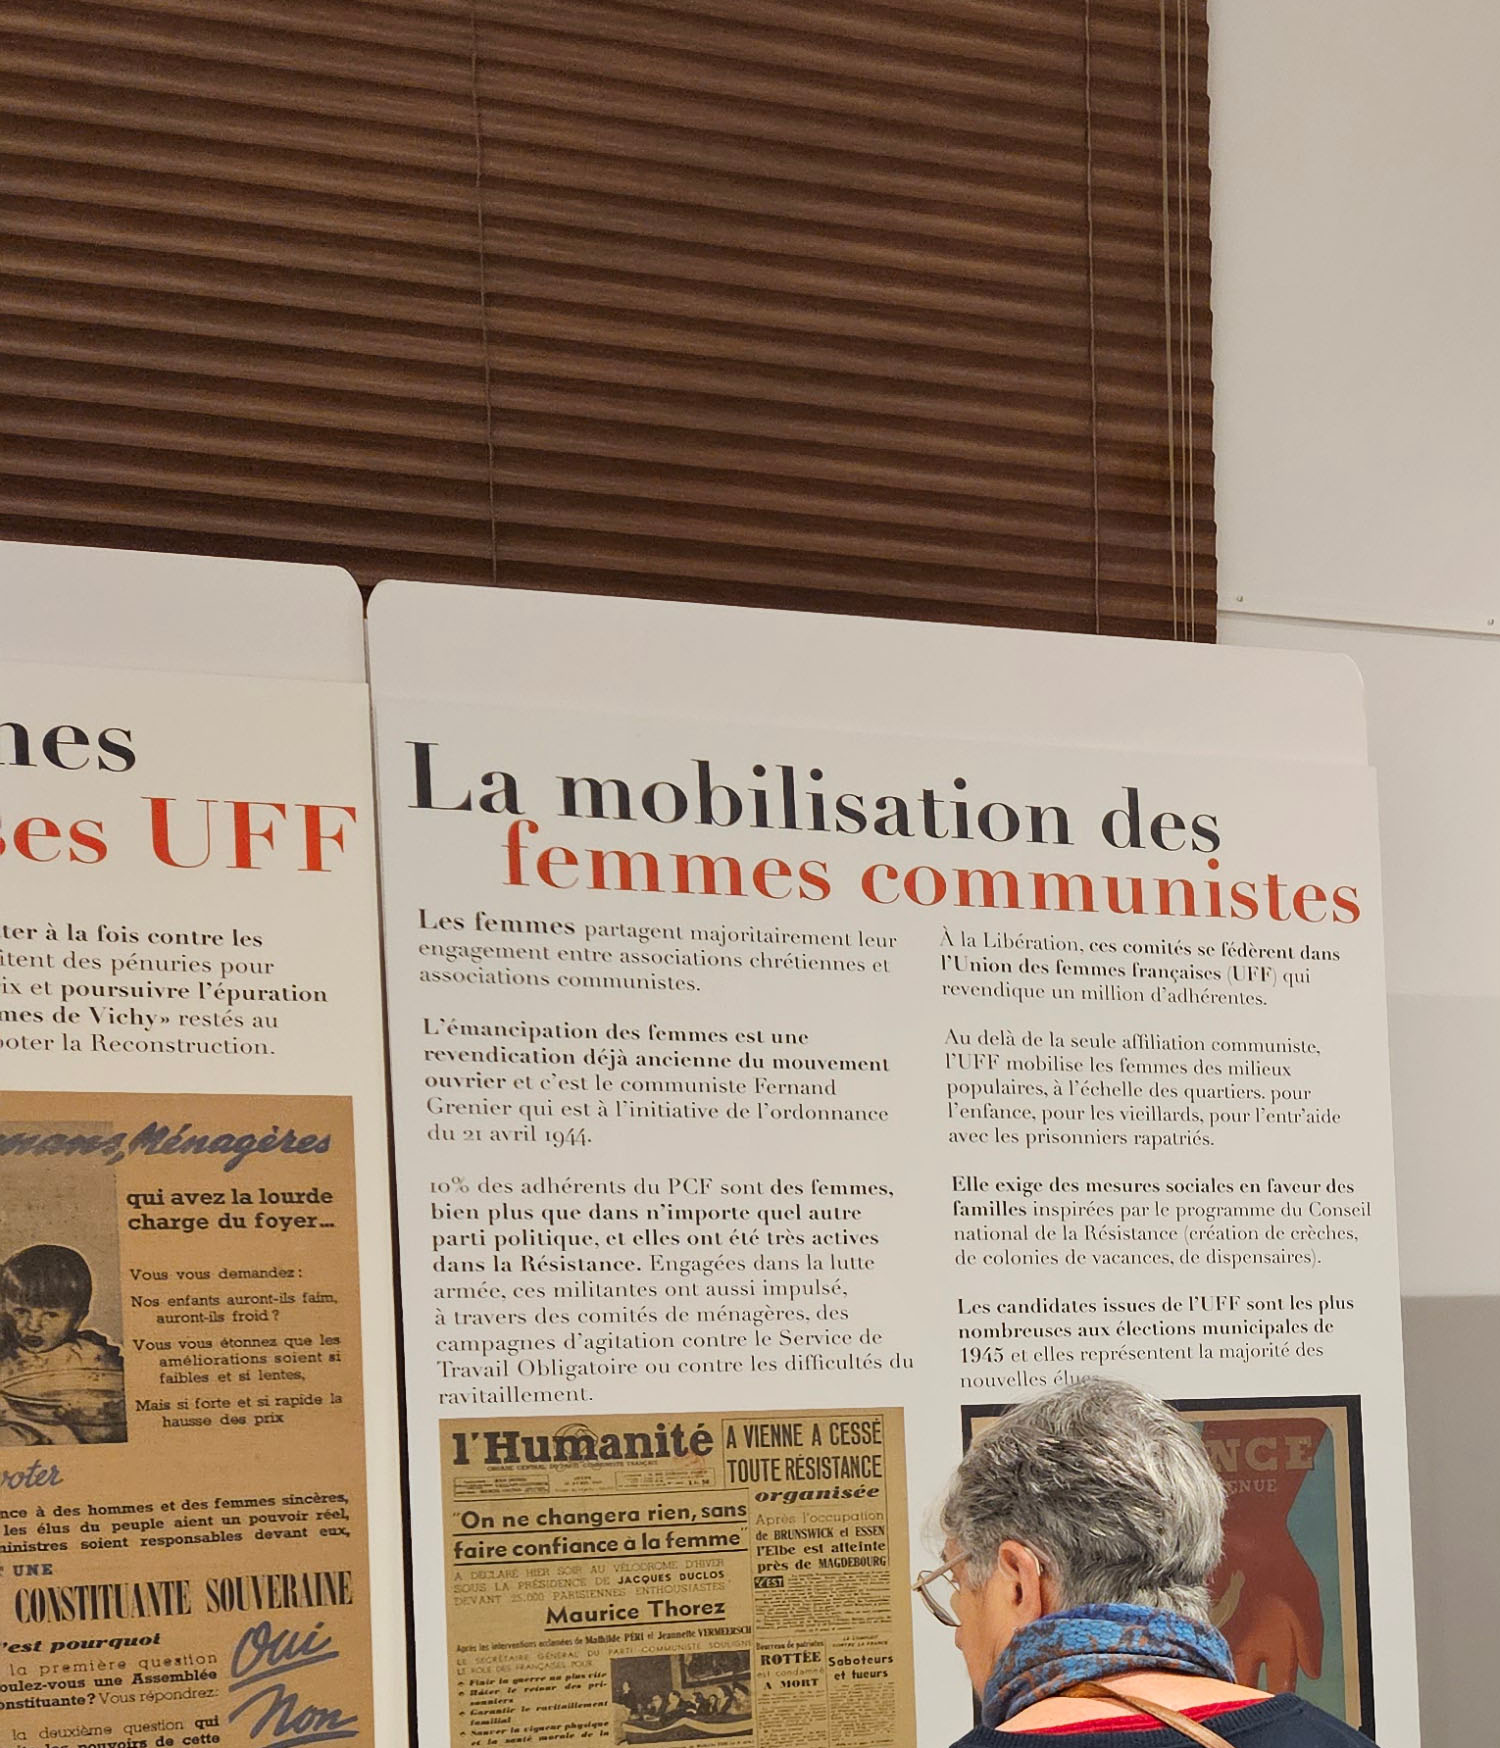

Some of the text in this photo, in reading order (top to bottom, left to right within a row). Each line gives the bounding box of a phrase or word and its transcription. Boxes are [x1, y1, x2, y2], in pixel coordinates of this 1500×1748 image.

[405, 741, 1221, 853] La mobilisation des
[141, 796, 357, 872] UFF
[501, 819, 1361, 924] femmes communistes
[45, 922, 58, 941] à
[67, 922, 89, 942] la
[97, 924, 140, 944] fois
[147, 931, 224, 946] contre
[232, 928, 263, 947] les
[419, 908, 897, 948] Les femmes partagent majoritairement leur
[30, 981, 50, 996] et
[61, 980, 190, 1003] poursuivre
[198, 981, 328, 1007] l'épuration
[52, 1005, 81, 1024] de
[88, 1006, 170, 1032] Vichy»
[179, 1009, 244, 1028] restés
[252, 1016, 278, 1028] au
[0, 1032, 275, 1055] oter la Reconstruction.
[423, 1045, 892, 1072] revendication déjà ancienne du mouvement
[128, 1121, 331, 1173] Ménagères
[125, 1187, 334, 1210] qui avez la lourde
[952, 1175, 1355, 1198] Elle exige des mesures sociales en faveur des
[127, 1212, 210, 1234] charge
[217, 1212, 248, 1230] du
[431, 1202, 862, 1226] bien plus que dans n'importe quel autre
[452, 1422, 714, 1465] l'Humanité
[726, 1418, 882, 1449] A VIENNE A CESSÉ
[727, 1458, 781, 1483] TOUTE
[785, 1453, 882, 1481] RÉSISTANCE
[755, 1484, 880, 1505] organisée
[502, 1512, 529, 1527] ne
[536, 1507, 640, 1527] changera
[648, 1503, 697, 1522] rien,
[701, 1503, 747, 1518] sans
[453, 1540, 507, 1560] faire
[512, 1536, 618, 1557] confiance
[624, 1536, 636, 1551] à
[642, 1532, 661, 1550] la
[617, 1570, 725, 1585] JACQUES DUCLOS
[14, 1570, 354, 1624] CONSTITUANTE SOUVERAINE
[546, 1600, 727, 1625] Maurice Thorez
[231, 1620, 332, 1677] Oui
[828, 1654, 894, 1667] Saboteurs
[834, 1669, 888, 1680] et tueurs
[229, 1683, 358, 1739] Non
